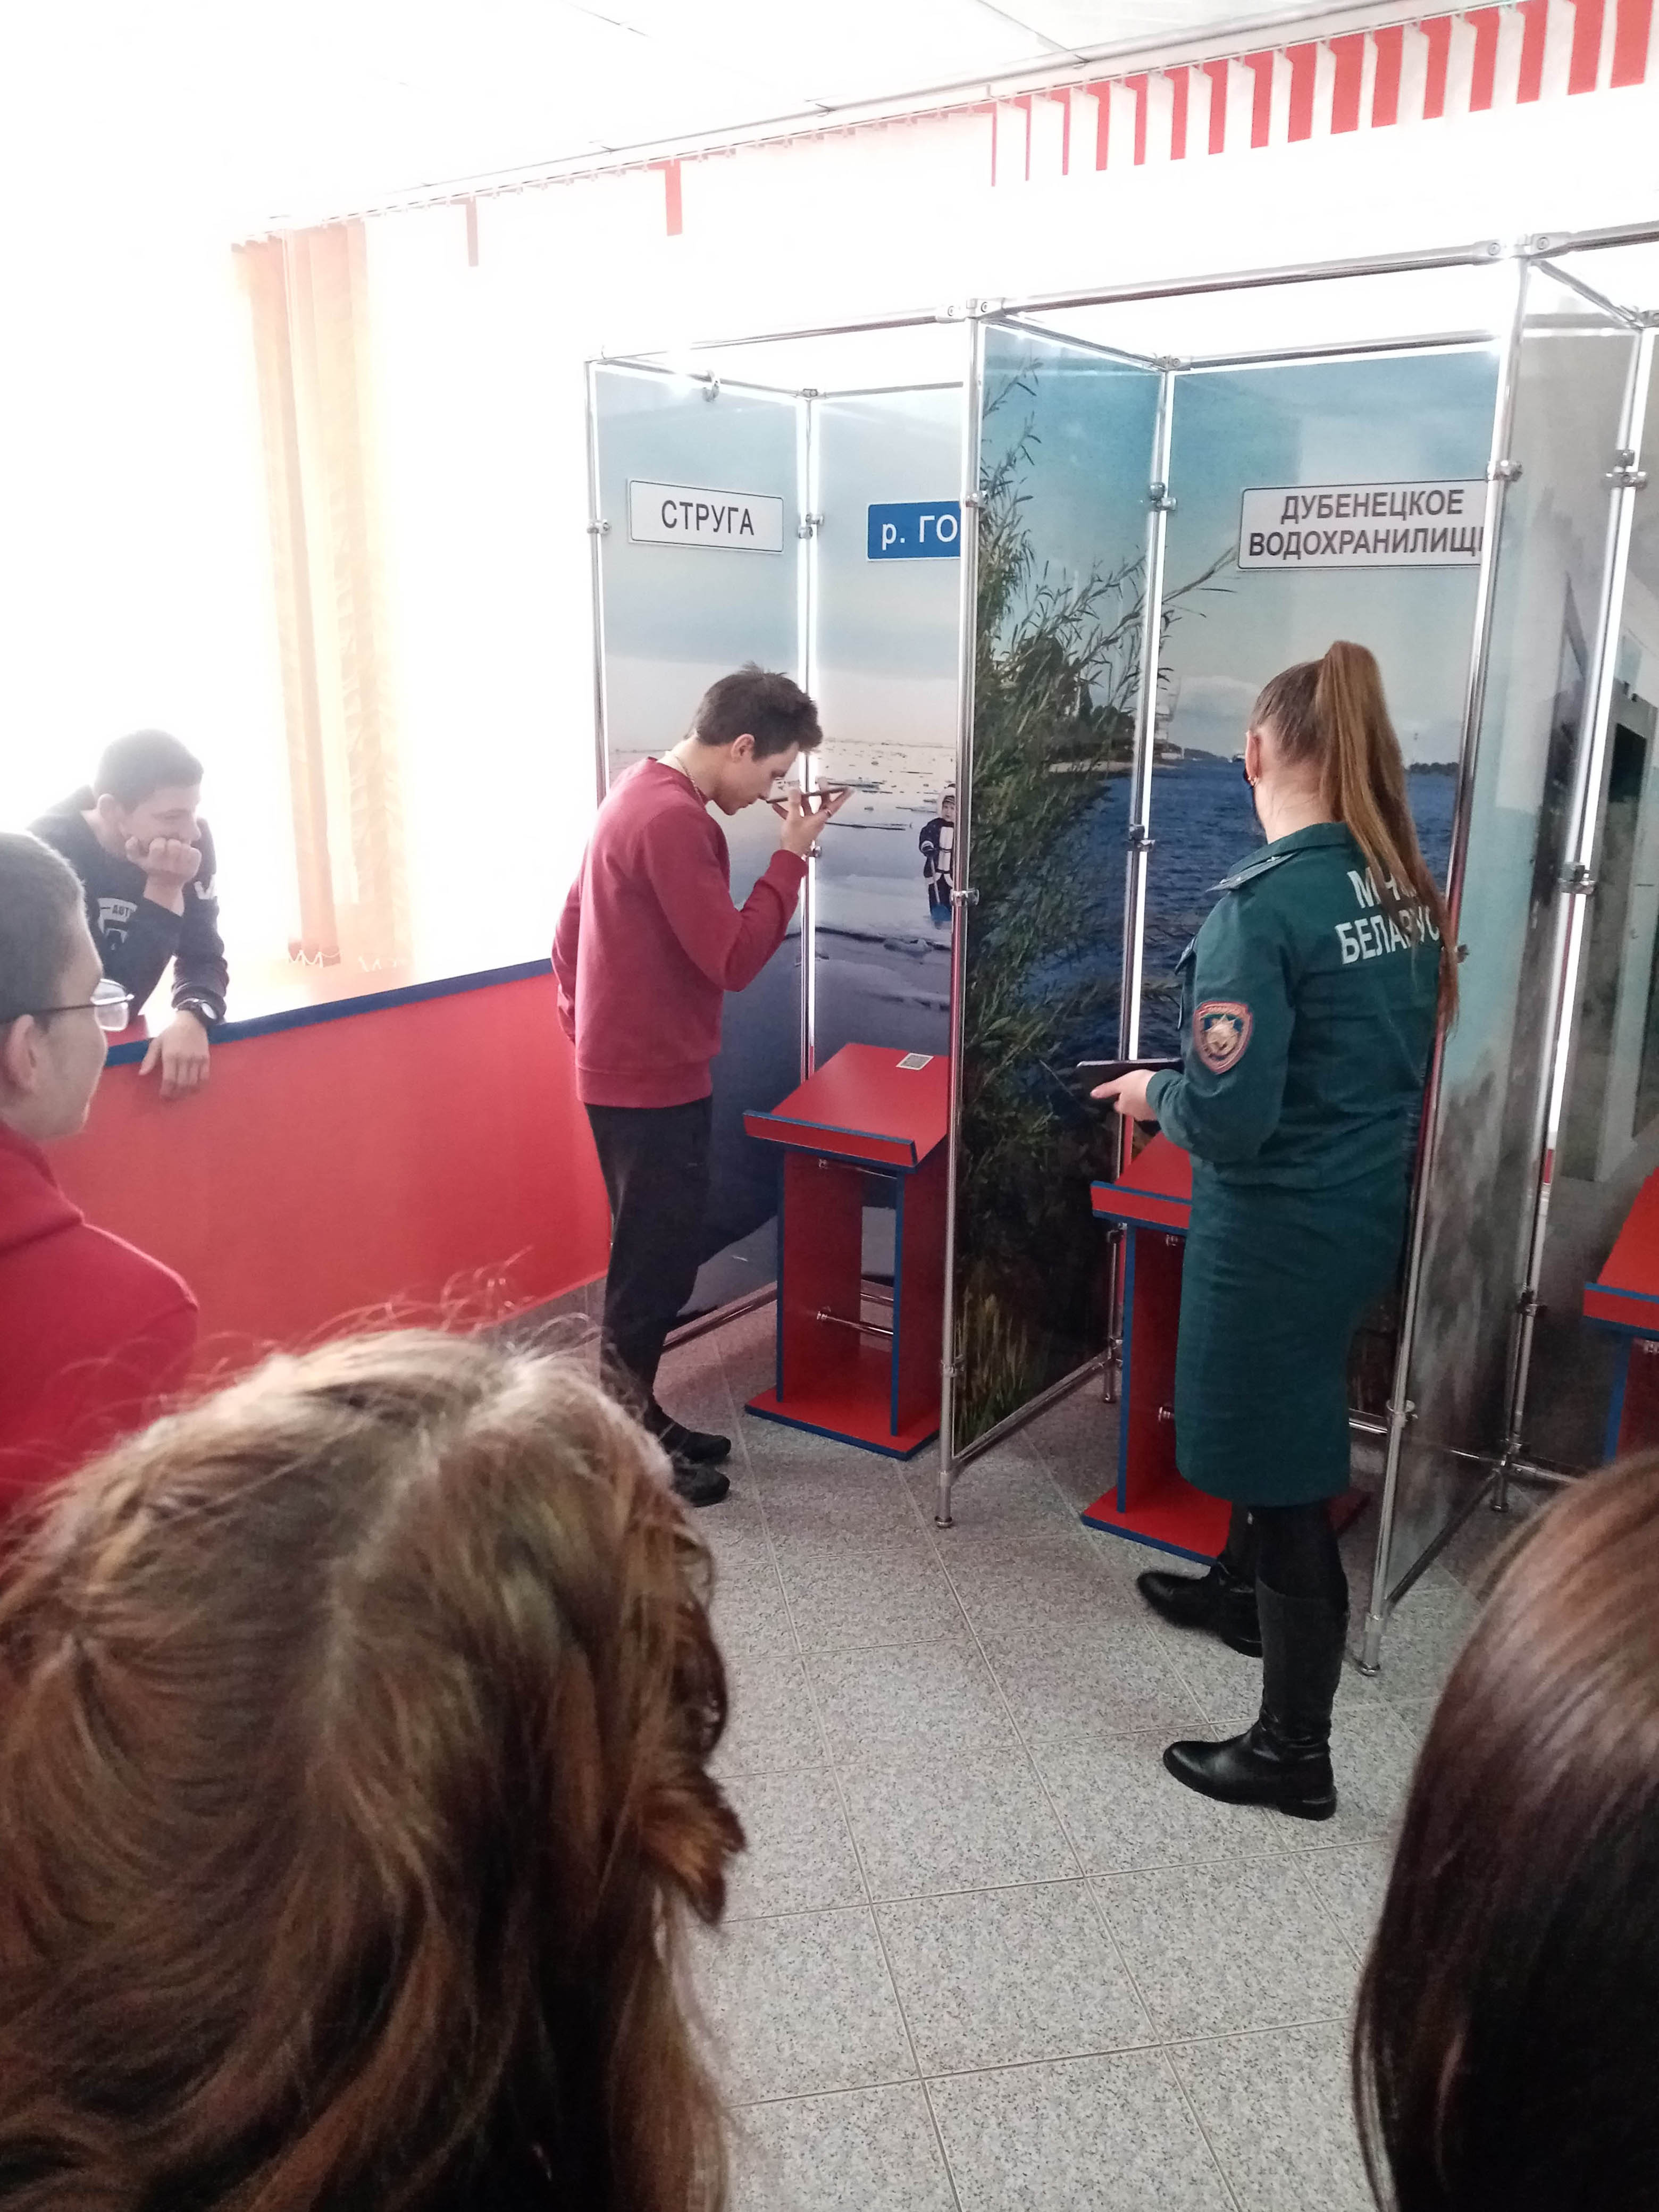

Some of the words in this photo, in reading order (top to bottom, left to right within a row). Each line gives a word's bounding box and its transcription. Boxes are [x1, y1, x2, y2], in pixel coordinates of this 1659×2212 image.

[661, 500, 754, 535] СТРУГА
[1280, 489, 1464, 525] ДУБЕНЕЦКОЕ
[882, 523, 905, 550] р.
[1249, 526, 1484, 560] ВОДОХРАНИЛИЩ
[1346, 867, 1417, 909] МЧ
